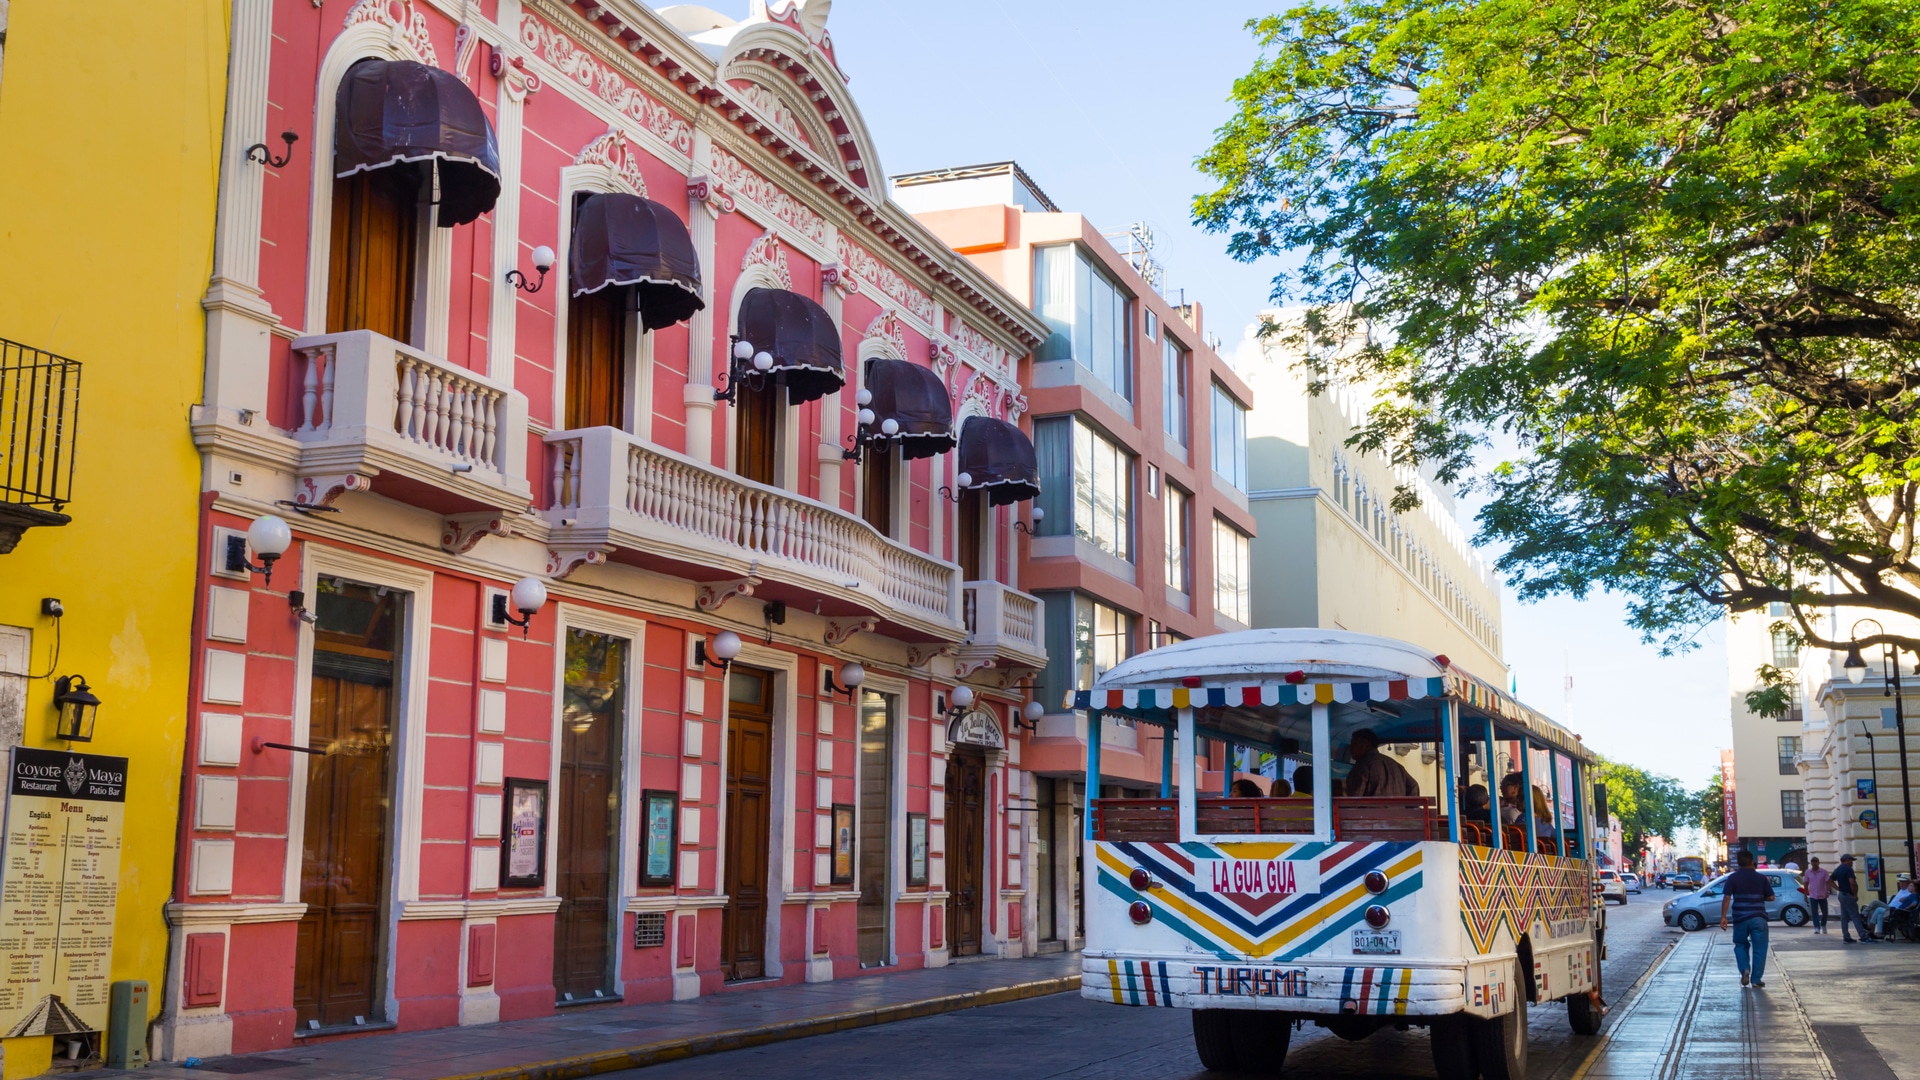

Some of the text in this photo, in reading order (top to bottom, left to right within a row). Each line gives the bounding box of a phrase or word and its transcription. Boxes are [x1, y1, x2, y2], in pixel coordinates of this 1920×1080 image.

[970, 712, 984, 730] Bella
[17, 762, 123, 784] Coyote Maya
[1724, 767, 1734, 792] CASA
[21, 780, 58, 792] Restaurant
[89, 786, 121, 796] Patio Bar
[60, 802, 84, 813] Menu
[1726, 799, 1735, 830] BALAM
[29, 811, 51, 821] English
[86, 814, 109, 823] Español
[1212, 860, 1297, 893] LA GUA GUA
[1354, 936, 1398, 948] 801-047-Y
[1194, 966, 1308, 997] TURISMO
